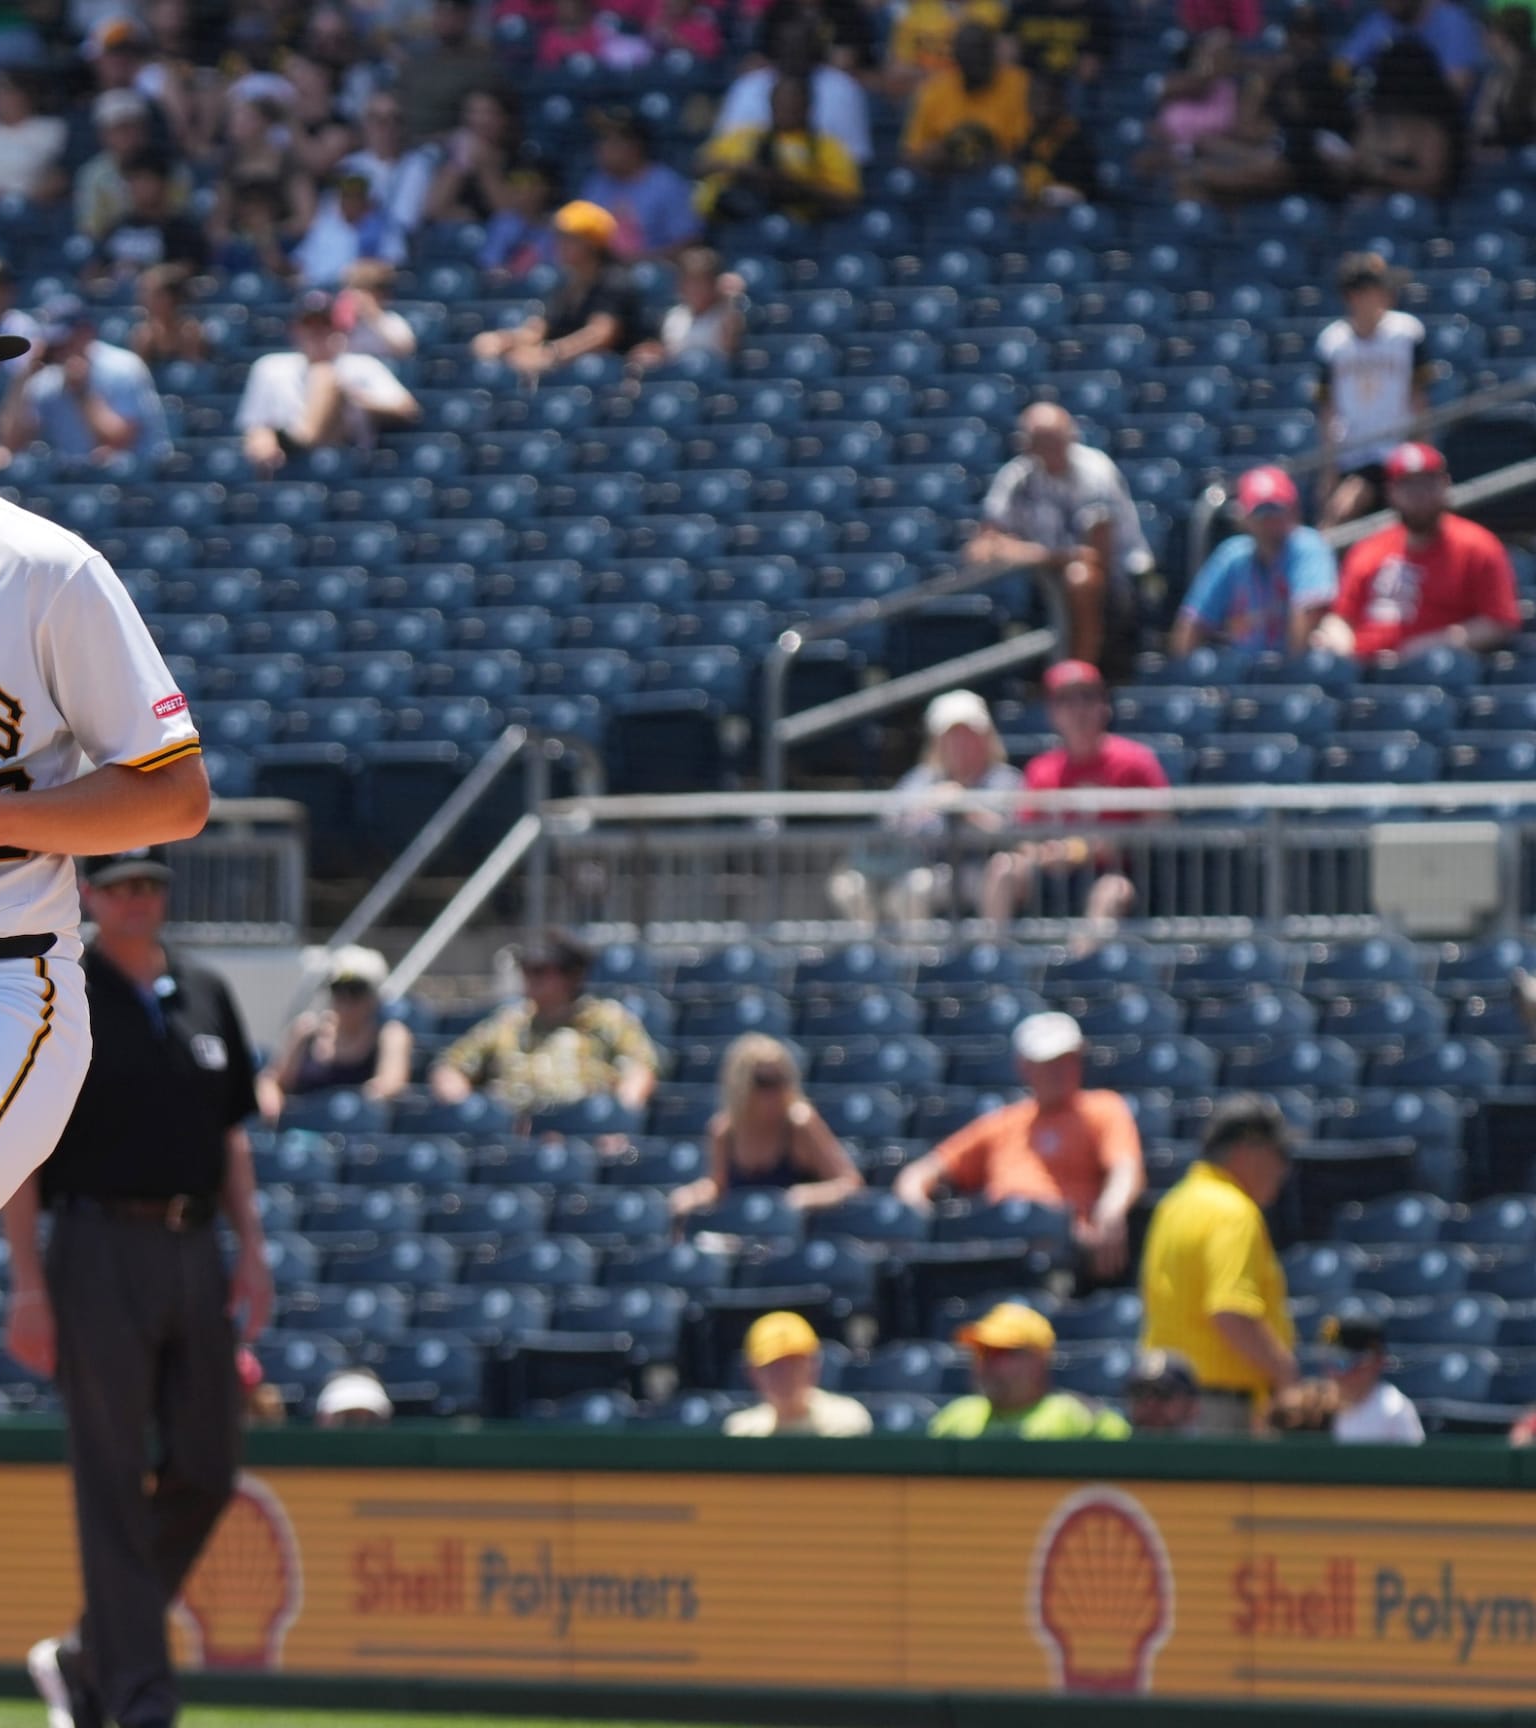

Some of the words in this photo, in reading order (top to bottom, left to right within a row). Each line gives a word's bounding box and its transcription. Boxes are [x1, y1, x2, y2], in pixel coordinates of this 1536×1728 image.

[155, 695, 185, 715] SHEETZ
[353, 1539, 462, 1615] Shell
[478, 1541, 698, 1637] Polymers
[1232, 1556, 1353, 1637] Shell
[1375, 1560, 1536, 1664] Polym
